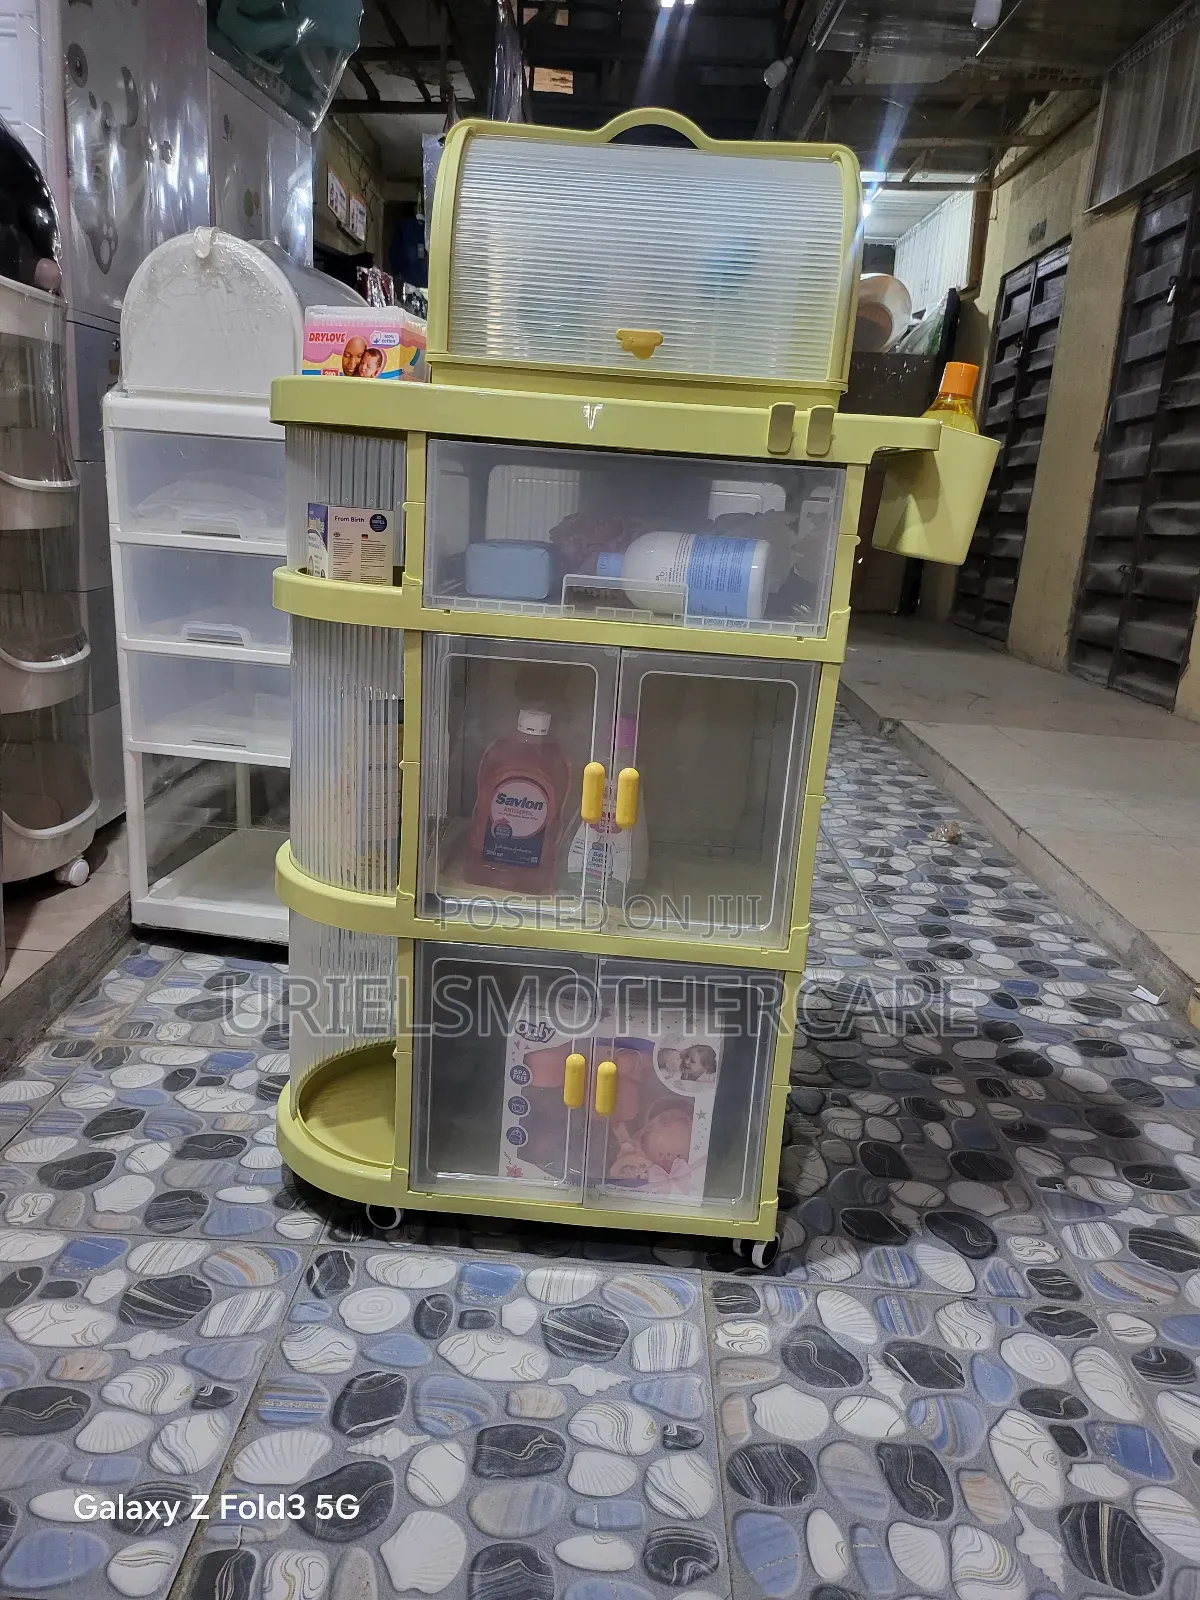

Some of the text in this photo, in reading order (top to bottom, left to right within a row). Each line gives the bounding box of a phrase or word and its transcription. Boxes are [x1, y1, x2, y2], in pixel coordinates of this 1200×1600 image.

[309, 331, 346, 343] DRYLOVE
[495, 792, 544, 811] Savlon
[513, 1068, 527, 1076] BPA
[512, 1074, 528, 1082] FREE
